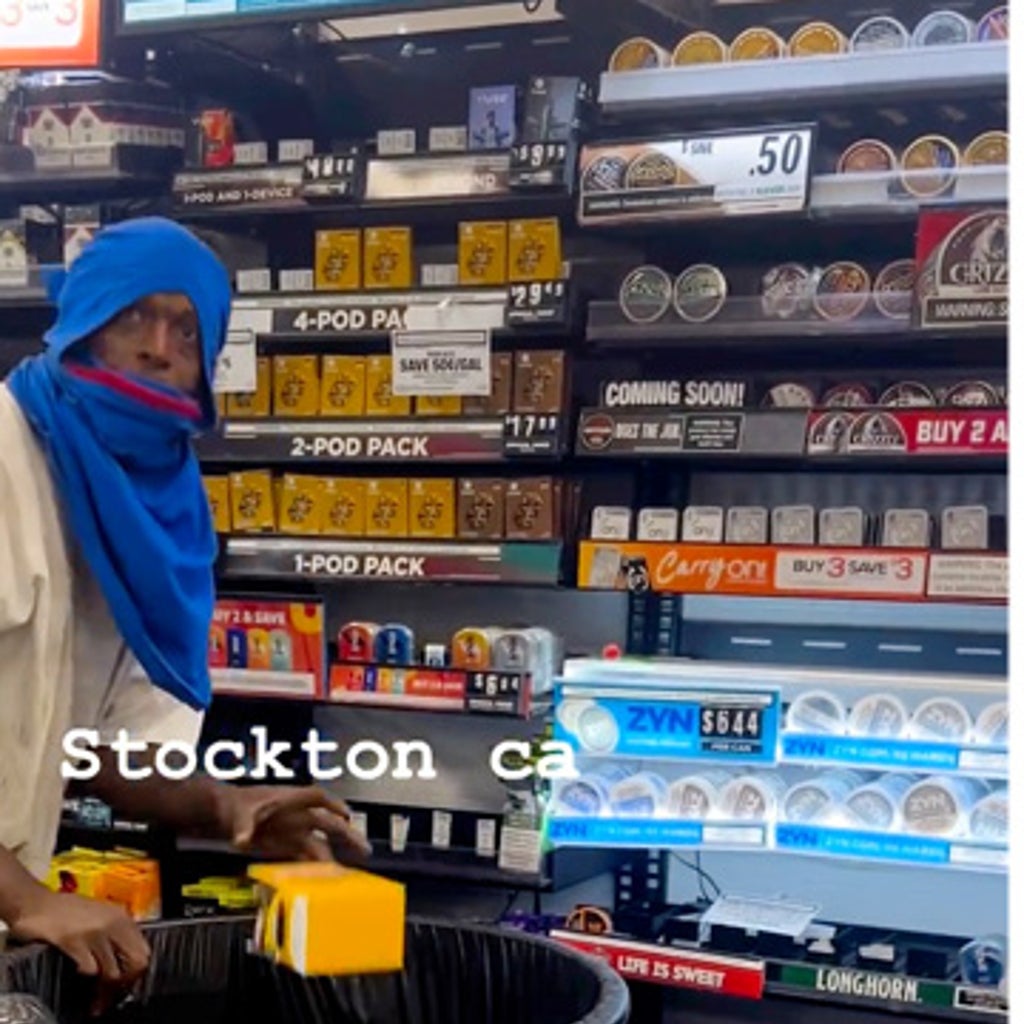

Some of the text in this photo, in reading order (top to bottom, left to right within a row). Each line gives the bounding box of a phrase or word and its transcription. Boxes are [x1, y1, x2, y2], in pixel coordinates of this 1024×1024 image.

[750, 134, 803, 177] .50
[217, 189, 242, 202] AND
[293, 309, 366, 331] 4-POD
[605, 380, 746, 408] COMING SOON!
[916, 420, 965, 443] BUY
[969, 420, 988, 443] 2
[290, 437, 429, 457] 2-POD PACK
[294, 553, 426, 576] 1-POD PACK
[792, 559, 826, 573] BUY
[826, 557, 846, 578] 3
[848, 562, 888, 576] SAVE
[625, 705, 695, 734] ZYN
[785, 735, 826, 757] ZYN
[552, 820, 588, 839] ZYN
[776, 824, 818, 847] ZYN
[617, 955, 726, 989] LIFE IS SWEET
